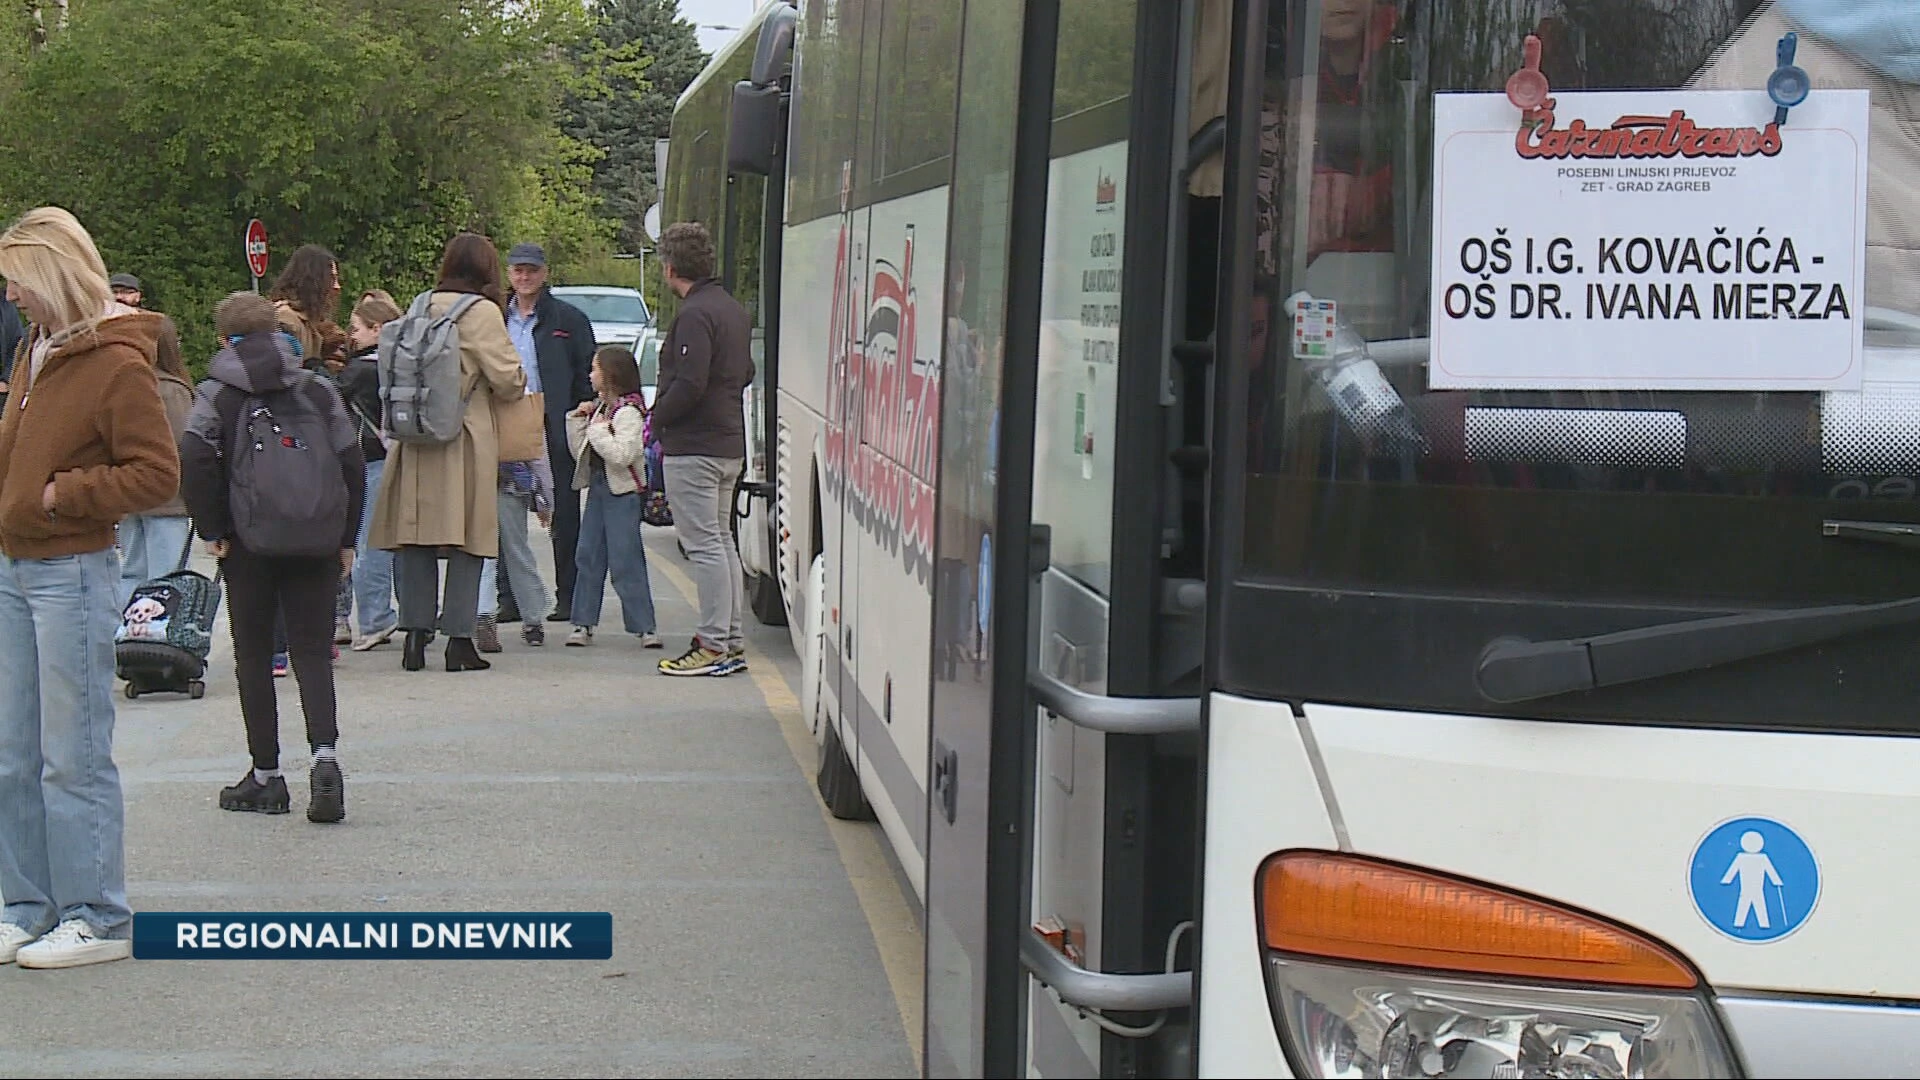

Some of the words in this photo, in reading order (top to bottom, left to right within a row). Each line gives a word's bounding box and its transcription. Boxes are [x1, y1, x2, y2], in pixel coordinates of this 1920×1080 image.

[1557, 167, 1614, 178] POSEBNI
[1617, 167, 1670, 178] LINIJSKI
[1673, 166, 1737, 178] PRIJEVOZ
[1580, 181, 1605, 193] ZET
[1616, 181, 1654, 192] GRAD
[1656, 180, 1711, 192] ZAGREB
[1460, 227, 1512, 275] OŠ
[1526, 237, 1584, 275] I.G.
[1598, 226, 1801, 275] KOVAČIĆA
[1444, 273, 1496, 320] OŠ
[1510, 283, 1572, 320] DR.
[1586, 283, 1701, 320] IVANA
[1712, 283, 1851, 320] MERZA
